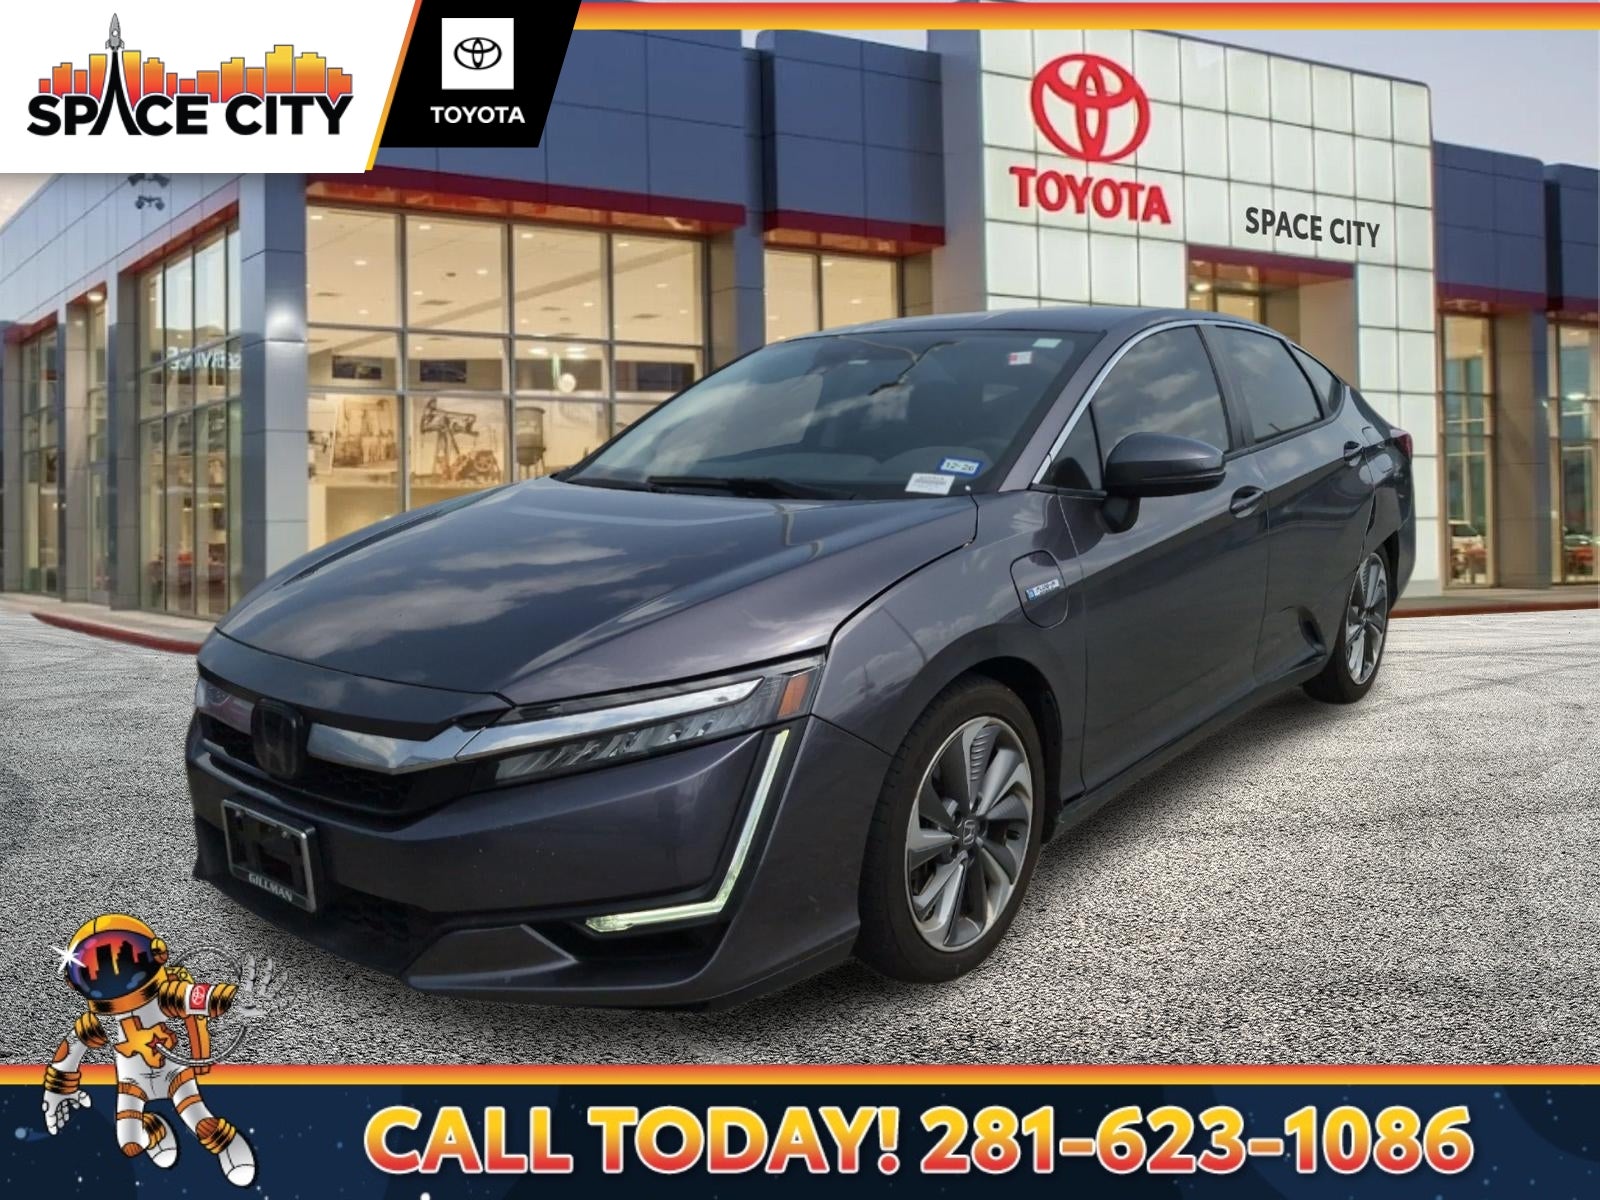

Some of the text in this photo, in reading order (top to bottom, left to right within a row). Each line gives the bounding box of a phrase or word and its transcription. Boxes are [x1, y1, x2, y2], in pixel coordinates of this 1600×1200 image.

[1009, 166, 1171, 225] TOYOTA
[1245, 206, 1381, 248] SPACE CITY
[249, 872, 293, 902] GILLMAN
